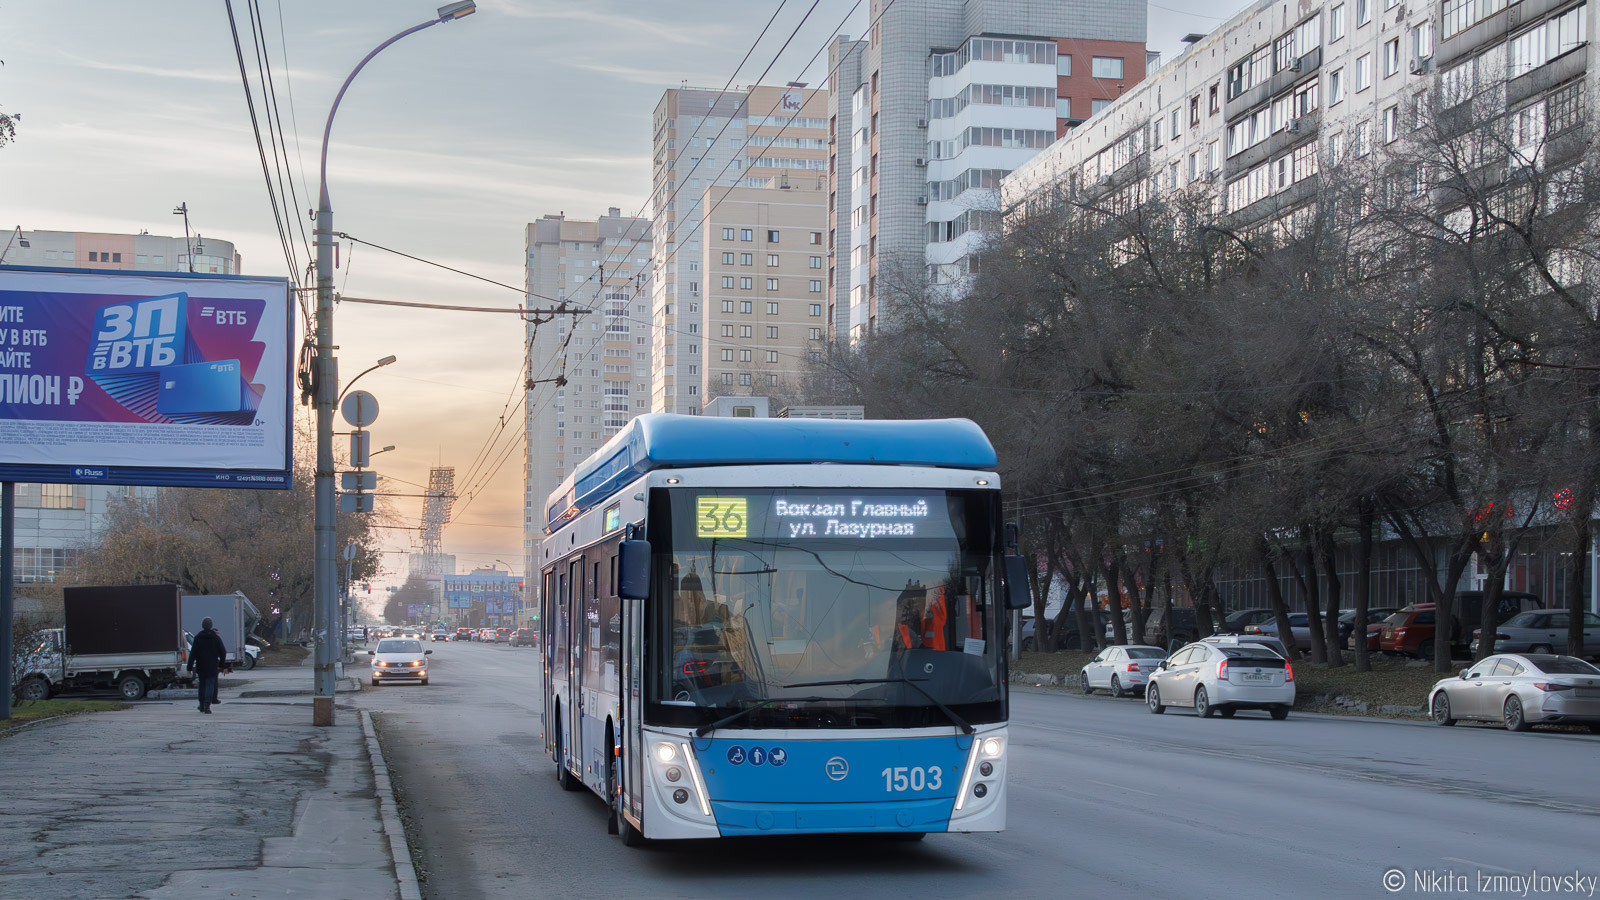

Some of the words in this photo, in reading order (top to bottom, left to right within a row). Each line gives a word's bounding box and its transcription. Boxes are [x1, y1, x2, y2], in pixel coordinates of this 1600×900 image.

[98, 297, 179, 341] ЗП
[216, 310, 247, 325] ВТБ
[11, 329, 20, 345] В
[23, 329, 47, 346] ВТБ
[109, 336, 176, 369] ВТБ
[217, 364, 235, 373] ВТБ
[254, 419, 265, 427] 0+
[84, 468, 104, 477] Russ
[776, 501, 845, 517] Вокзал
[851, 500, 929, 517] Главный
[699, 503, 743, 532] 36
[789, 522, 817, 538] ул.
[824, 519, 915, 538] Лазурная
[882, 766, 942, 792] 1503
